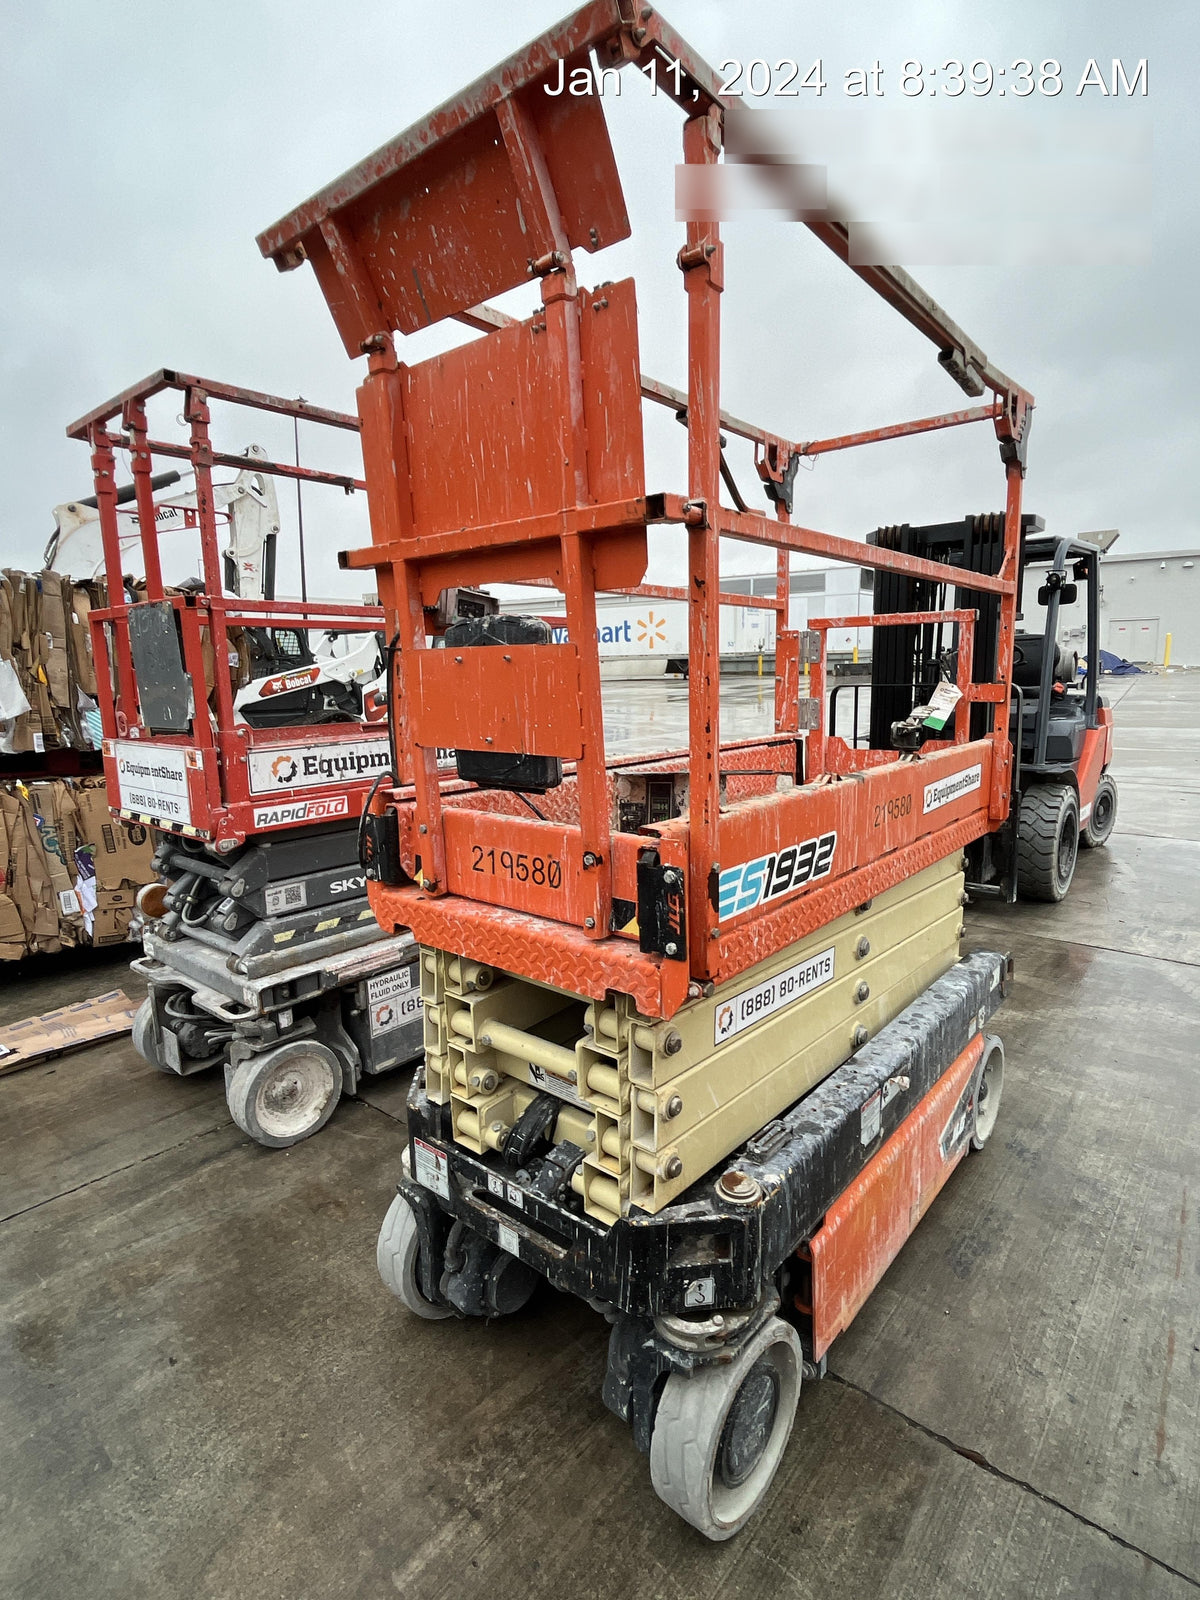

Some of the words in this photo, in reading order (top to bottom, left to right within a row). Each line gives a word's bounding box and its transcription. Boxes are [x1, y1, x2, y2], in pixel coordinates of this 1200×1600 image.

[285, 674, 312, 690] Bobcat
[126, 761, 183, 781] EquipmentShare
[933, 773, 980, 803] EquipmentShare
[874, 794, 912, 828] 219580
[472, 845, 562, 889] 219580
[719, 834, 836, 919] ES1932
[369, 970, 409, 991] HYDRAULIC
[370, 986, 391, 1000] FLUID
[392, 981, 409, 992] ONLY
[741, 985, 775, 1021] (888)
[779, 957, 831, 998] 80-RENTS
